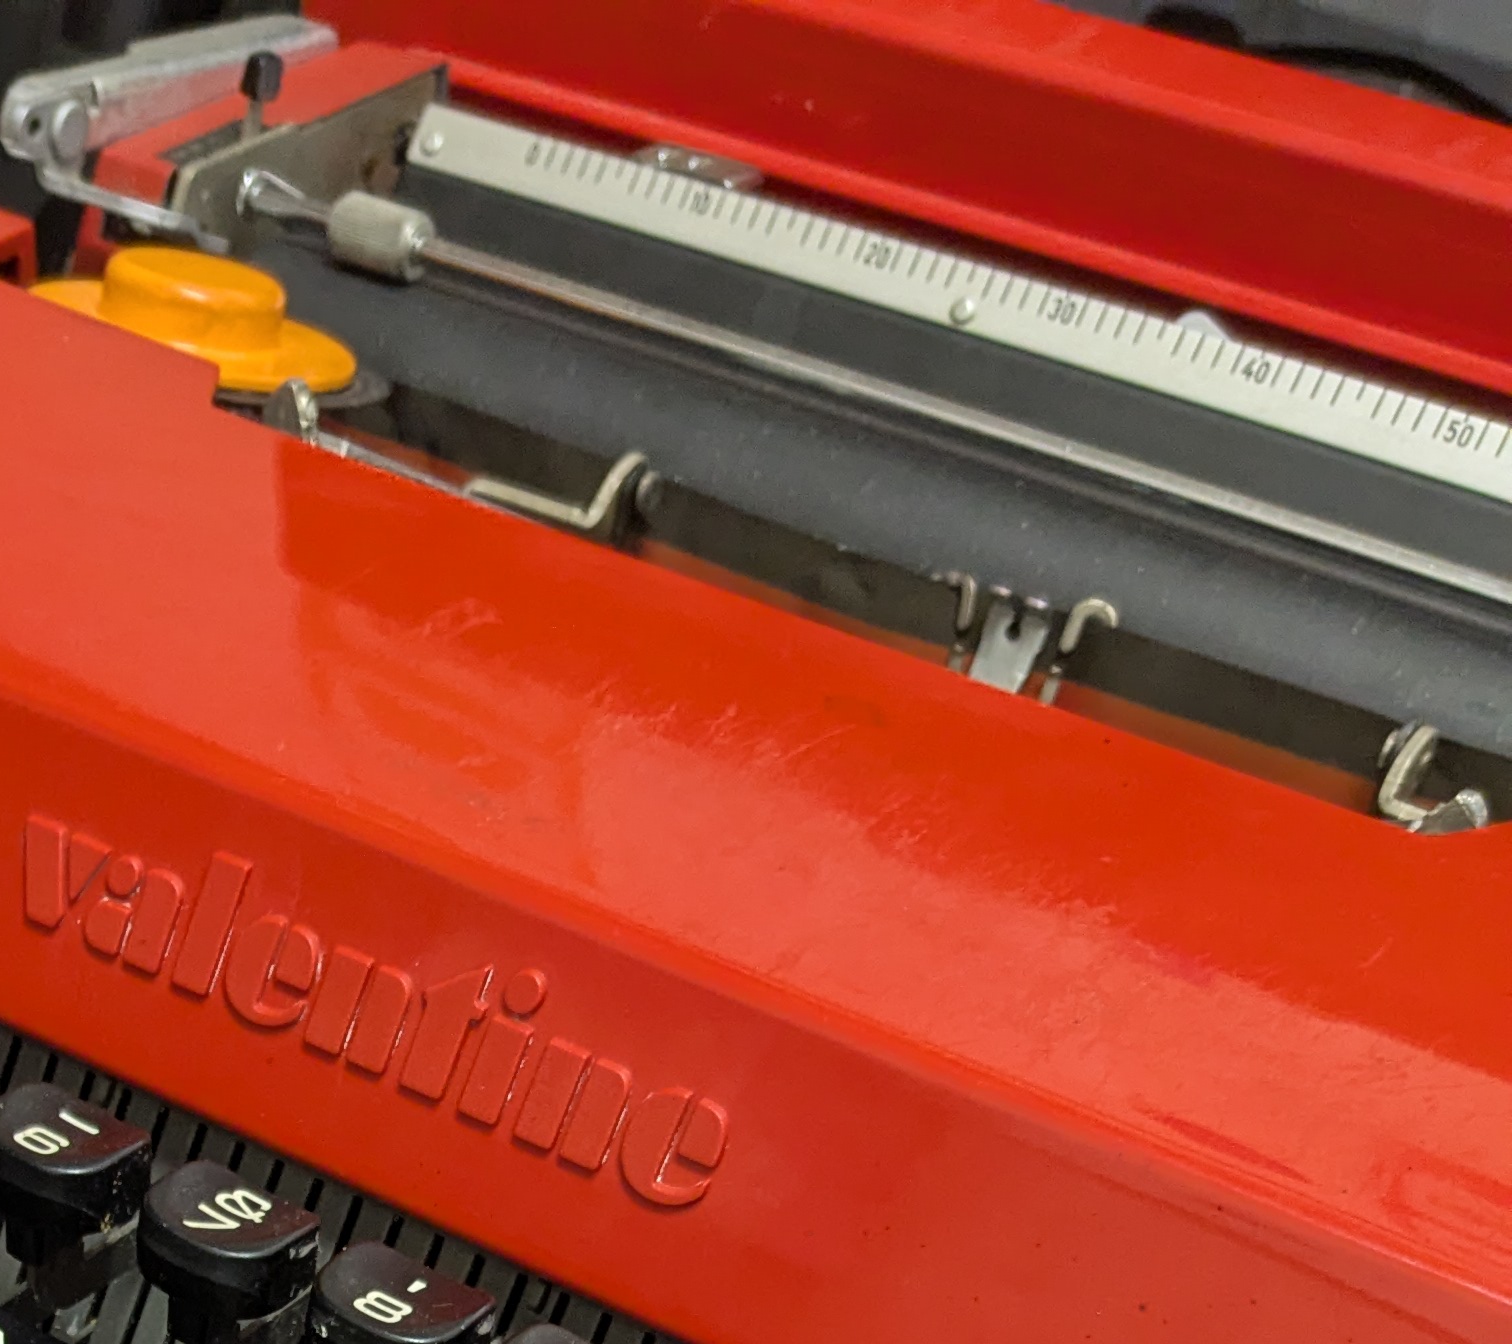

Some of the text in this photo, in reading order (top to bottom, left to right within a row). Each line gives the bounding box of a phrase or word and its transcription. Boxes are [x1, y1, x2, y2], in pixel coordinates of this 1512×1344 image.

[863, 241, 891, 271] 20
[1047, 298, 1077, 327] 30
[1240, 355, 1272, 387] 40
[1442, 418, 1476, 450] 50
[23, 813, 730, 1207] valentine
[11, 1123, 71, 1156] 6
[181, 1201, 242, 1231] 7
[352, 1289, 414, 1325] 8
